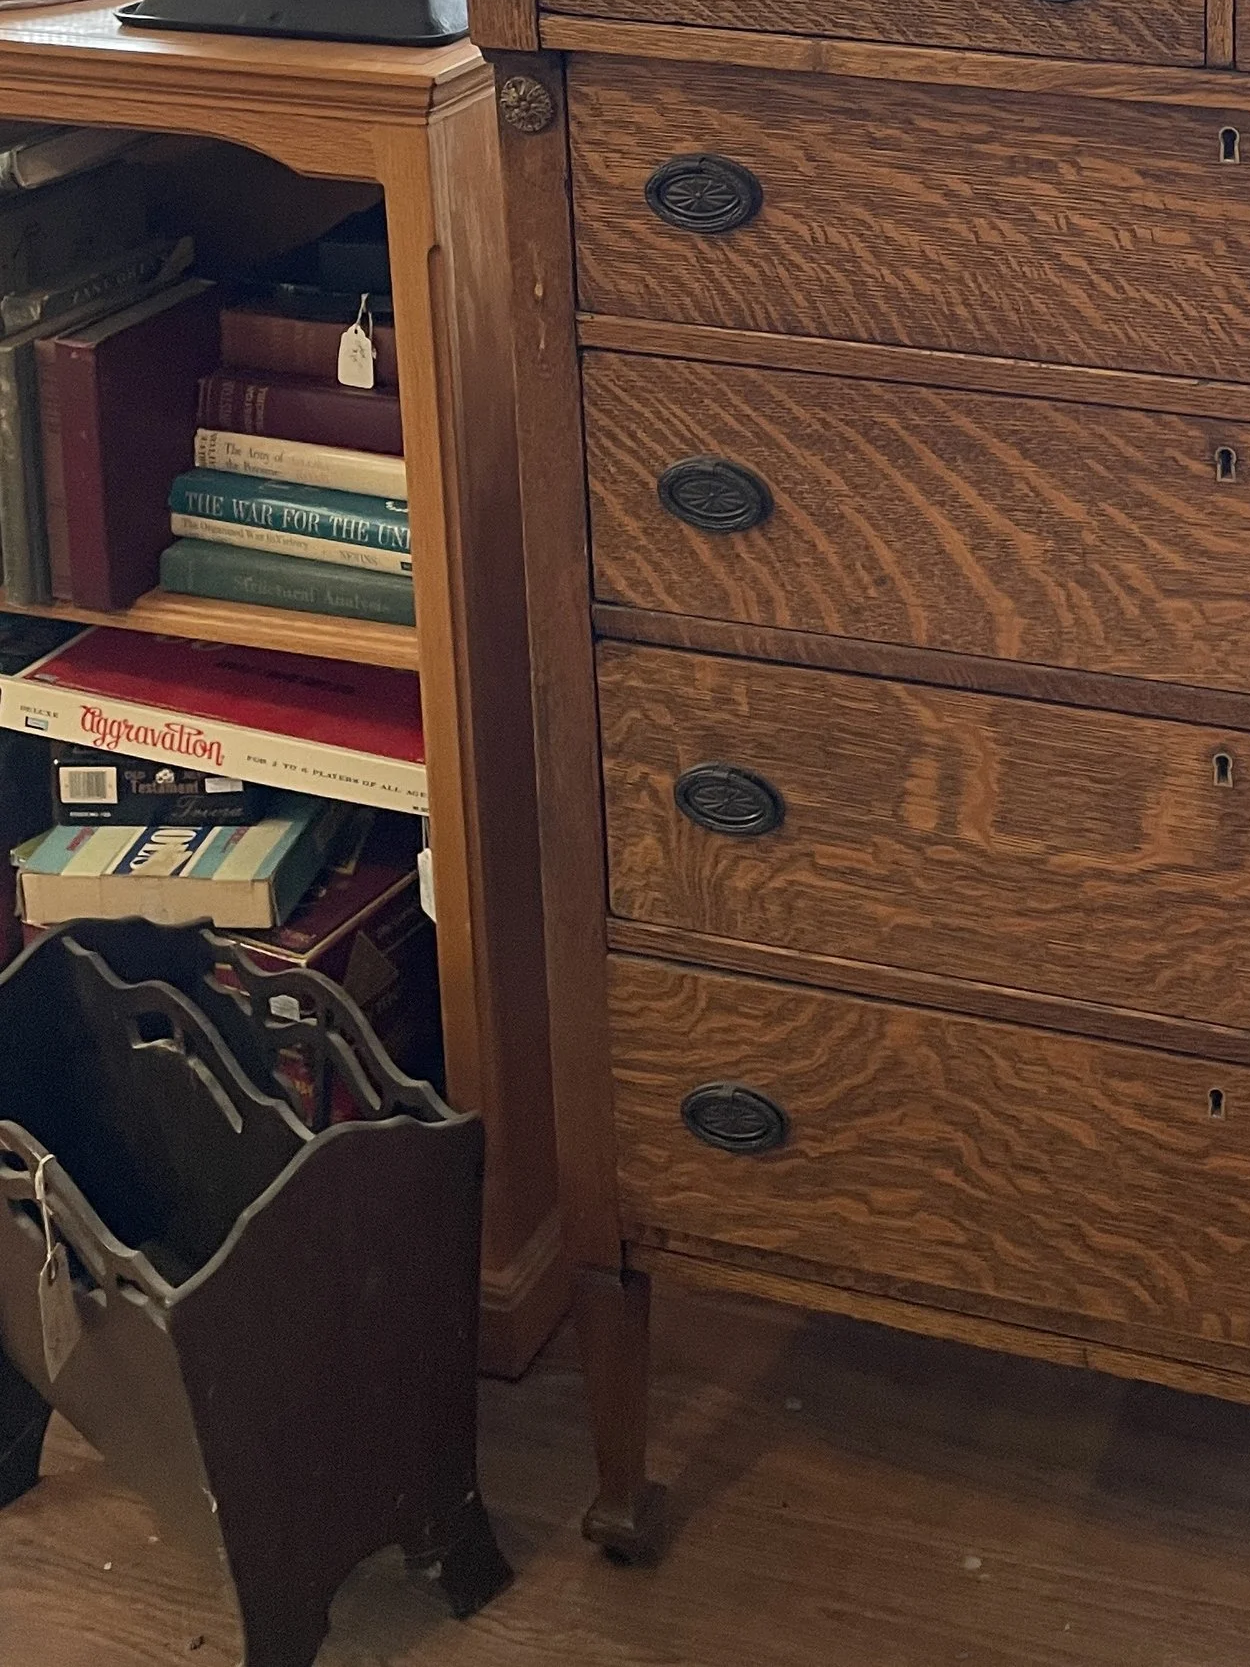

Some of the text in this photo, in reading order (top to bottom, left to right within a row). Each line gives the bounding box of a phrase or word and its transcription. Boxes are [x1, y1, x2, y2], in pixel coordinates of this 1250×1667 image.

[225, 442, 284, 464] The Army of
[185, 491, 224, 516] THE
[232, 499, 273, 527] WAR
[282, 509, 320, 534] FOR
[329, 515, 370, 541] THE
[20, 705, 59, 719] DELUXE
[79, 705, 223, 766] Aggravation
[130, 780, 199, 795] Testament
[246, 755, 267, 765] FOR
[282, 763, 297, 772] TO
[312, 769, 360, 786] PLAYERS
[362, 779, 376, 788] OF
[381, 784, 401, 794] ALL
